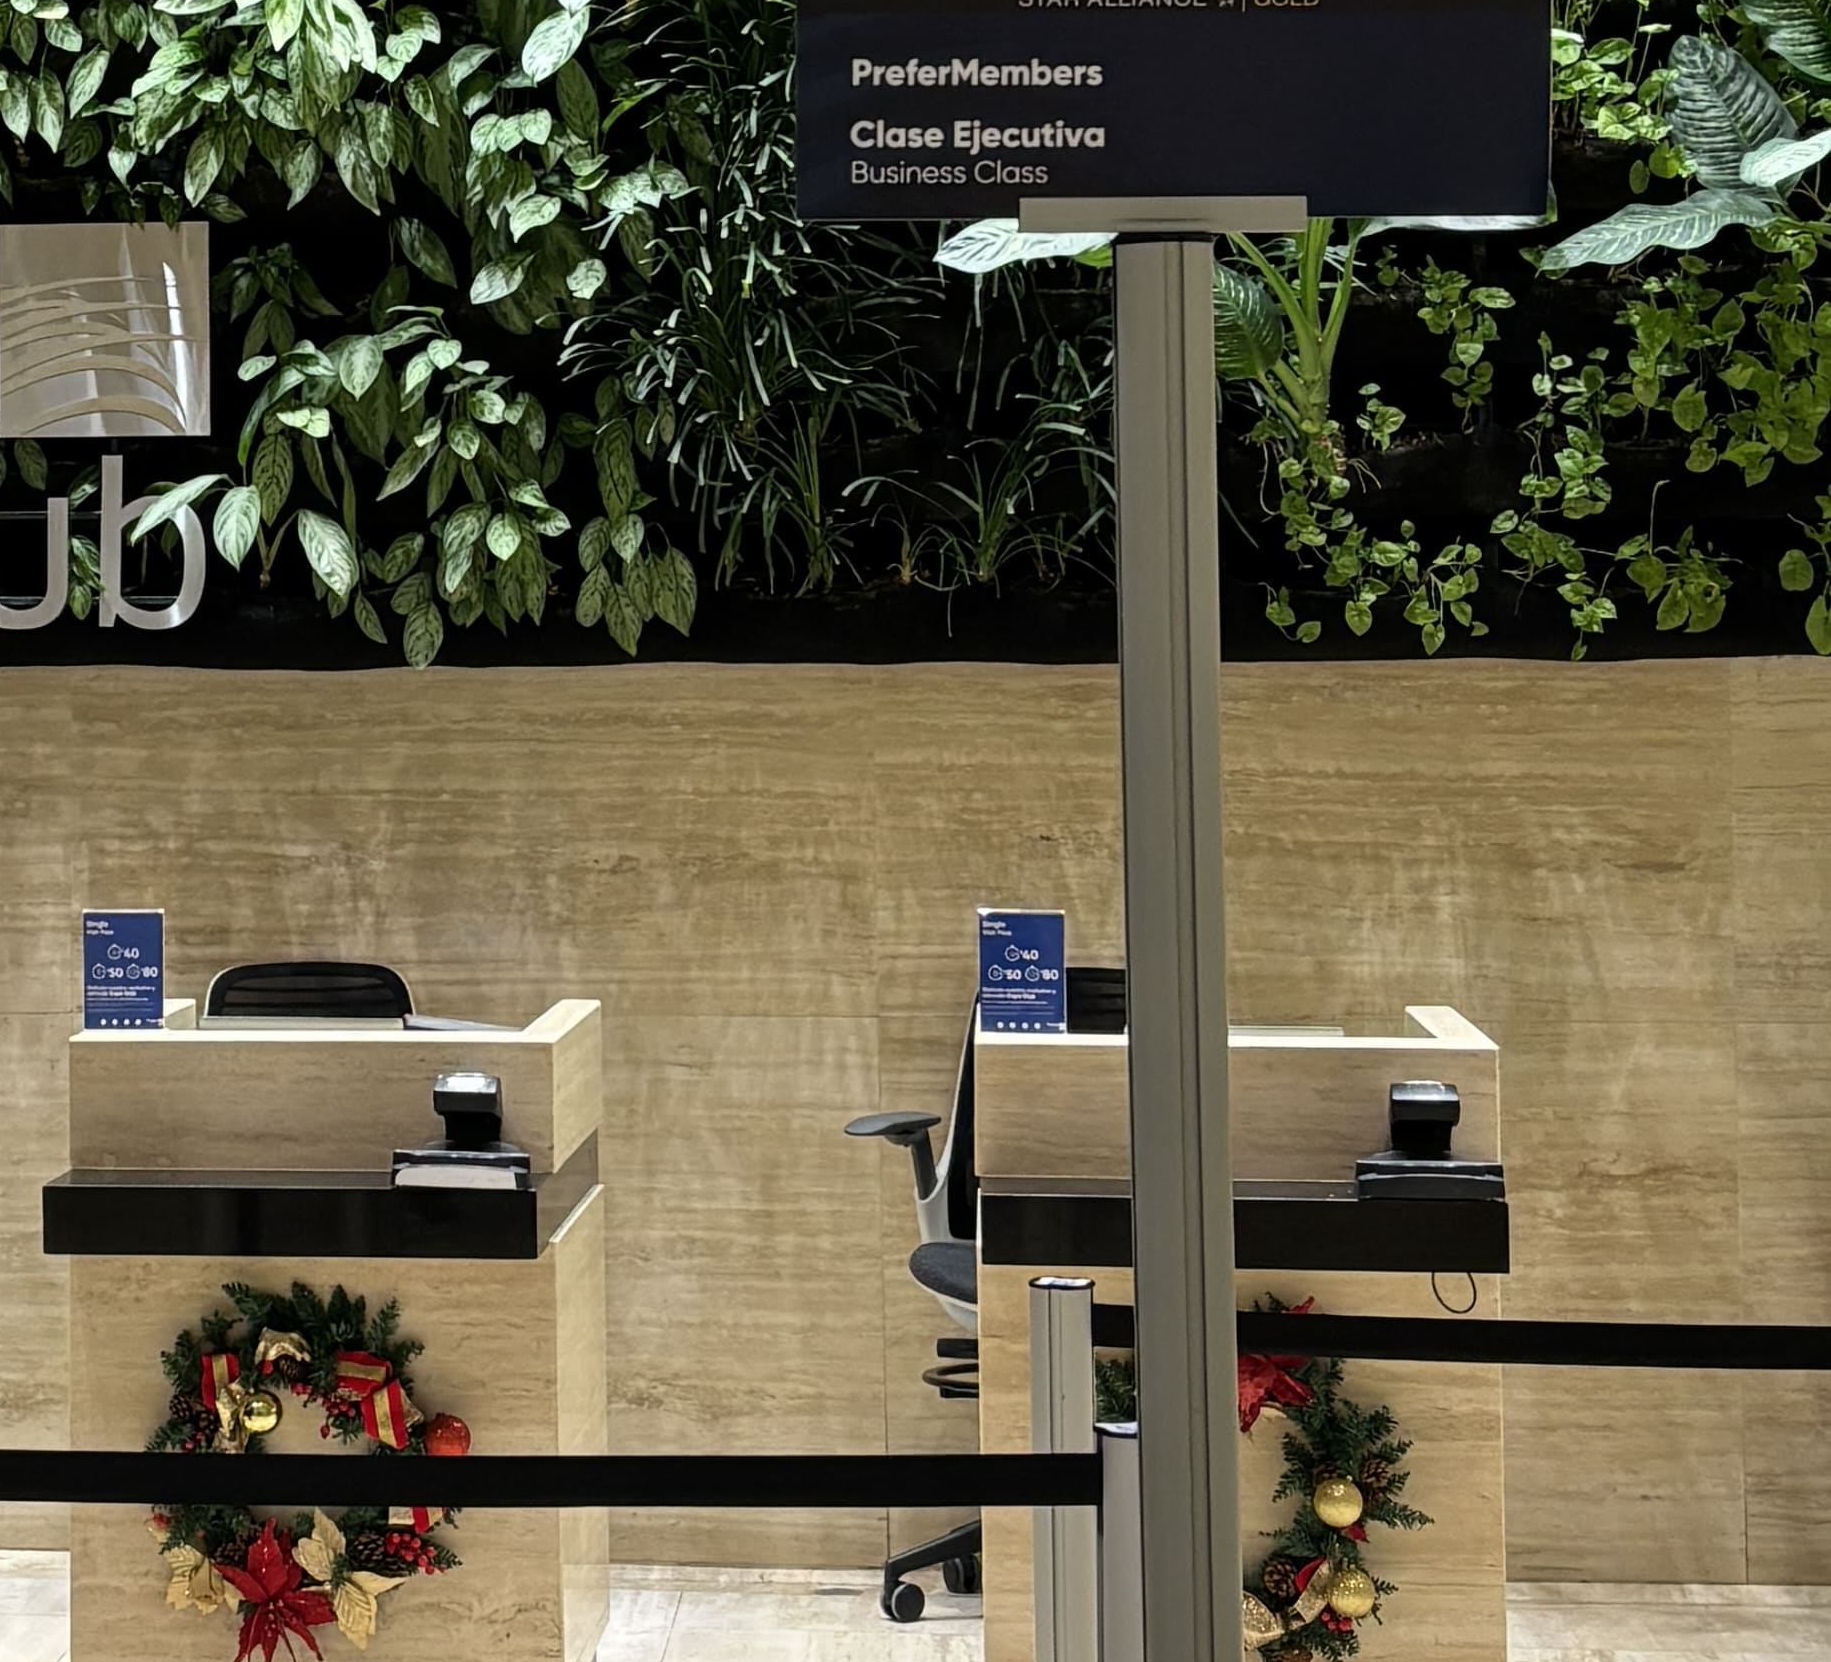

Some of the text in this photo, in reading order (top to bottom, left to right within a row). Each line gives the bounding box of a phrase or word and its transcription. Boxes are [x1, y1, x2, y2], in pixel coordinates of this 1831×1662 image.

[851, 58, 1103, 87] PreferMembers
[850, 119, 1106, 156] Clase Ejecutiva
[851, 160, 1049, 184] Business Class
